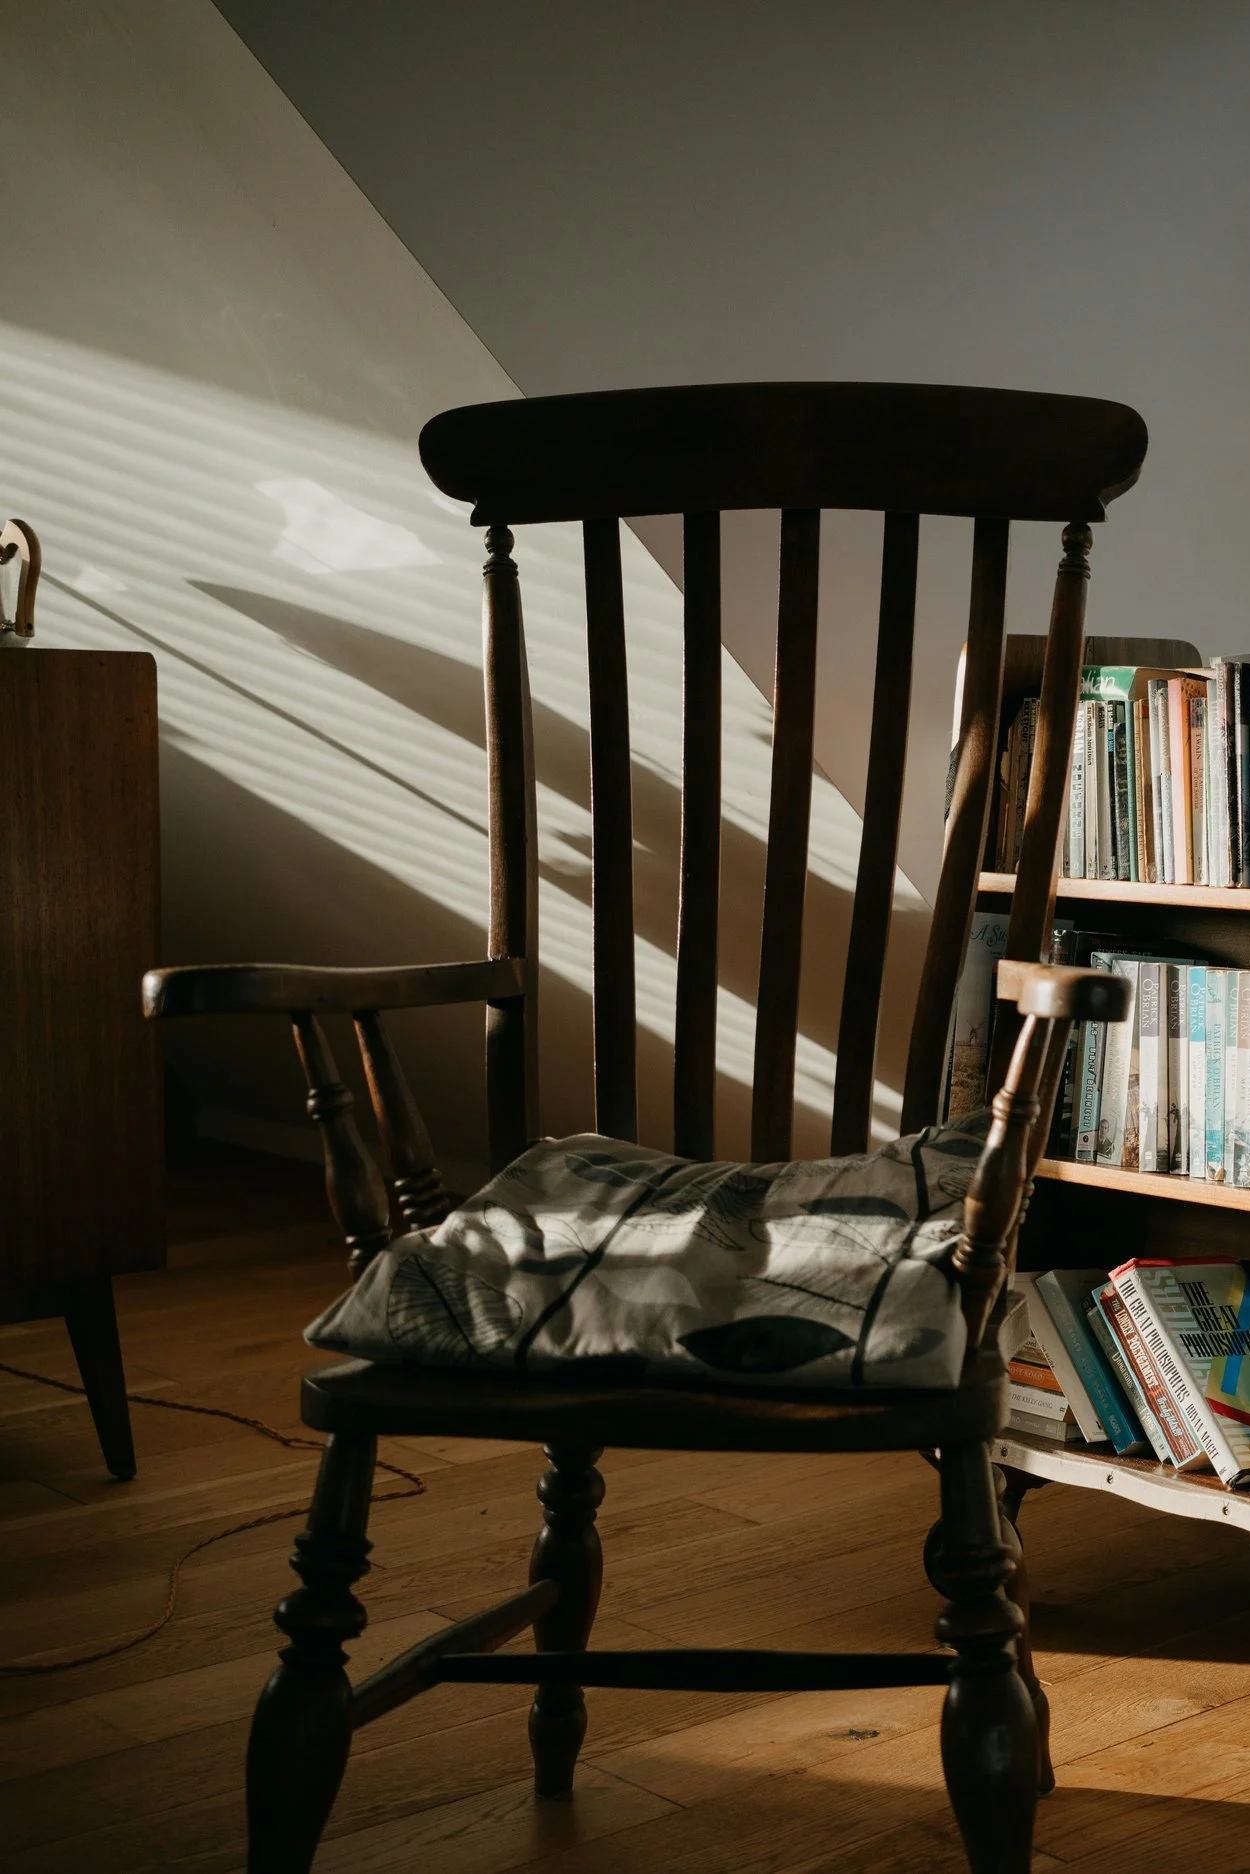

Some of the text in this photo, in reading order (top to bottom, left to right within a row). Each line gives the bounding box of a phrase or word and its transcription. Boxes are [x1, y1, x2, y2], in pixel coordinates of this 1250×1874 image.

[1195, 734, 1203, 760] TWAIN
[1071, 764, 1083, 839] NOCTURNE
[1142, 978, 1153, 1028] O'BRIAN
[1151, 982, 1159, 1025] PATRICK
[1170, 979, 1181, 1030] O'BRIAN
[1178, 983, 1186, 1026] PATRICK
[1190, 983, 1202, 1033] O'BRIAN
[1197, 987, 1206, 1028] PATRICK
[1212, 1023, 1222, 1108] PATRICK O'BRIAN
[1083, 1078, 1095, 1129] BENNETT
[1111, 1299, 1122, 1314] THE
[1178, 1280, 1215, 1307] THE
[1114, 1311, 1135, 1338] LONELY
[1191, 1304, 1242, 1334] GREAT
[1111, 1350, 1133, 1391] DANGEROUS
[1118, 1278, 1137, 1299] THE
[1128, 1298, 1153, 1331] GREAT
[1144, 1328, 1191, 1404] PHILOSOPHERS
[1184, 1403, 1203, 1431] BRYAN
[1198, 1431, 1219, 1460] MAGEE
[1127, 1334, 1159, 1389] POLYGAMIST
[1011, 1393, 1053, 1408] THE KELLY GANG
